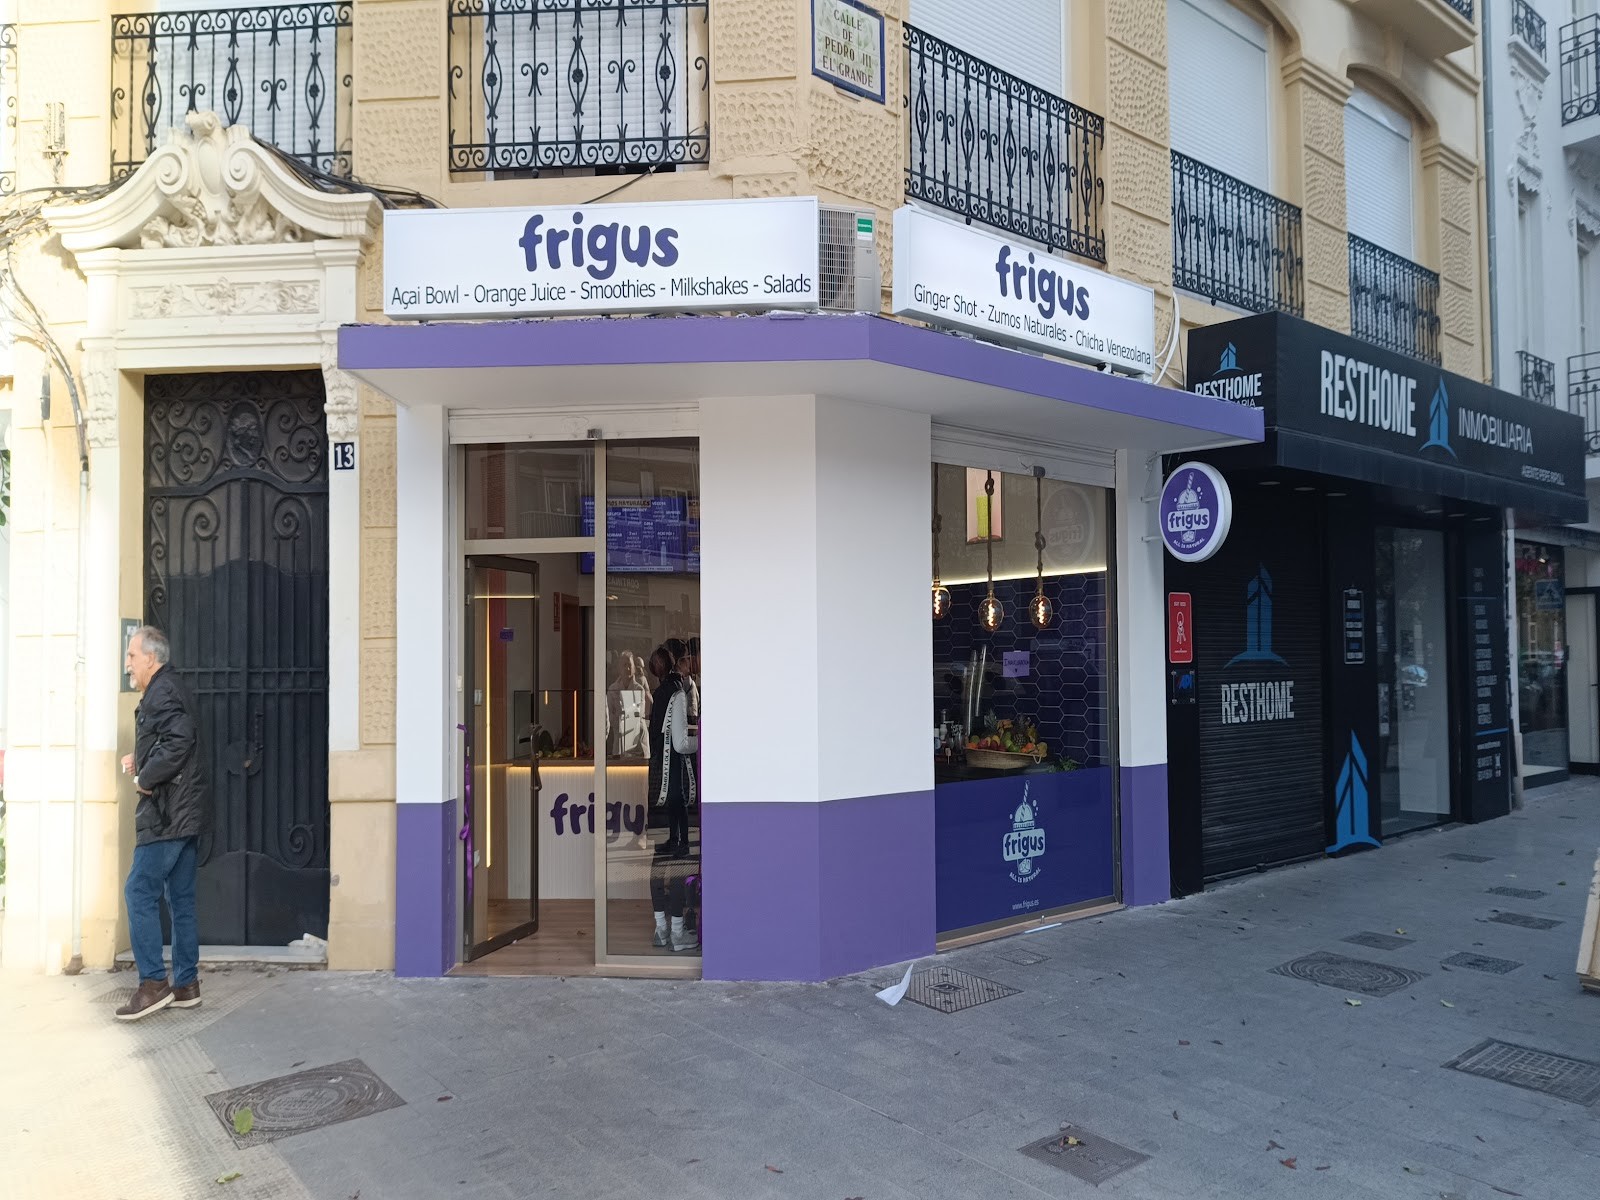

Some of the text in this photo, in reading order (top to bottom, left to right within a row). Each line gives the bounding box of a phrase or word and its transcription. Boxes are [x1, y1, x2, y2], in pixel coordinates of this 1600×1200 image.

[834, 10, 862, 31] CALLE
[843, 29, 852, 42] DE
[825, 37, 871, 68] PEDRO III
[823, 56, 873, 88] EL GRANDE
[519, 212, 678, 280] frigus
[392, 286, 421, 309] Açai
[426, 285, 459, 304] Bowl
[474, 284, 526, 307] Orange
[530, 283, 565, 301] Juice
[581, 280, 655, 299] Smoothies
[671, 276, 748, 296] Milkshakes
[764, 274, 811, 294] Salads
[995, 246, 1090, 320] frigus
[914, 284, 950, 311] Ginger
[954, 295, 977, 317] Shot
[988, 304, 1020, 330] Zumos
[1024, 314, 1066, 342] Naturales
[1076, 330, 1103, 352] Chicha
[1107, 338, 1150, 365] Venezolana
[1320, 350, 1417, 437] RESTHOME
[1458, 407, 1533, 455] INMOBILIARIA
[335, 444, 354, 468] 13
[1169, 512, 1209, 530] frigus
[1221, 681, 1294, 724] RESTHOME
[550, 793, 649, 843] frigu
[1005, 831, 1044, 858] frigus
[1009, 872, 1017, 881] ALL
[1023, 867, 1041, 883] NATURAL
[1012, 899, 1040, 910] www.frigus.es
